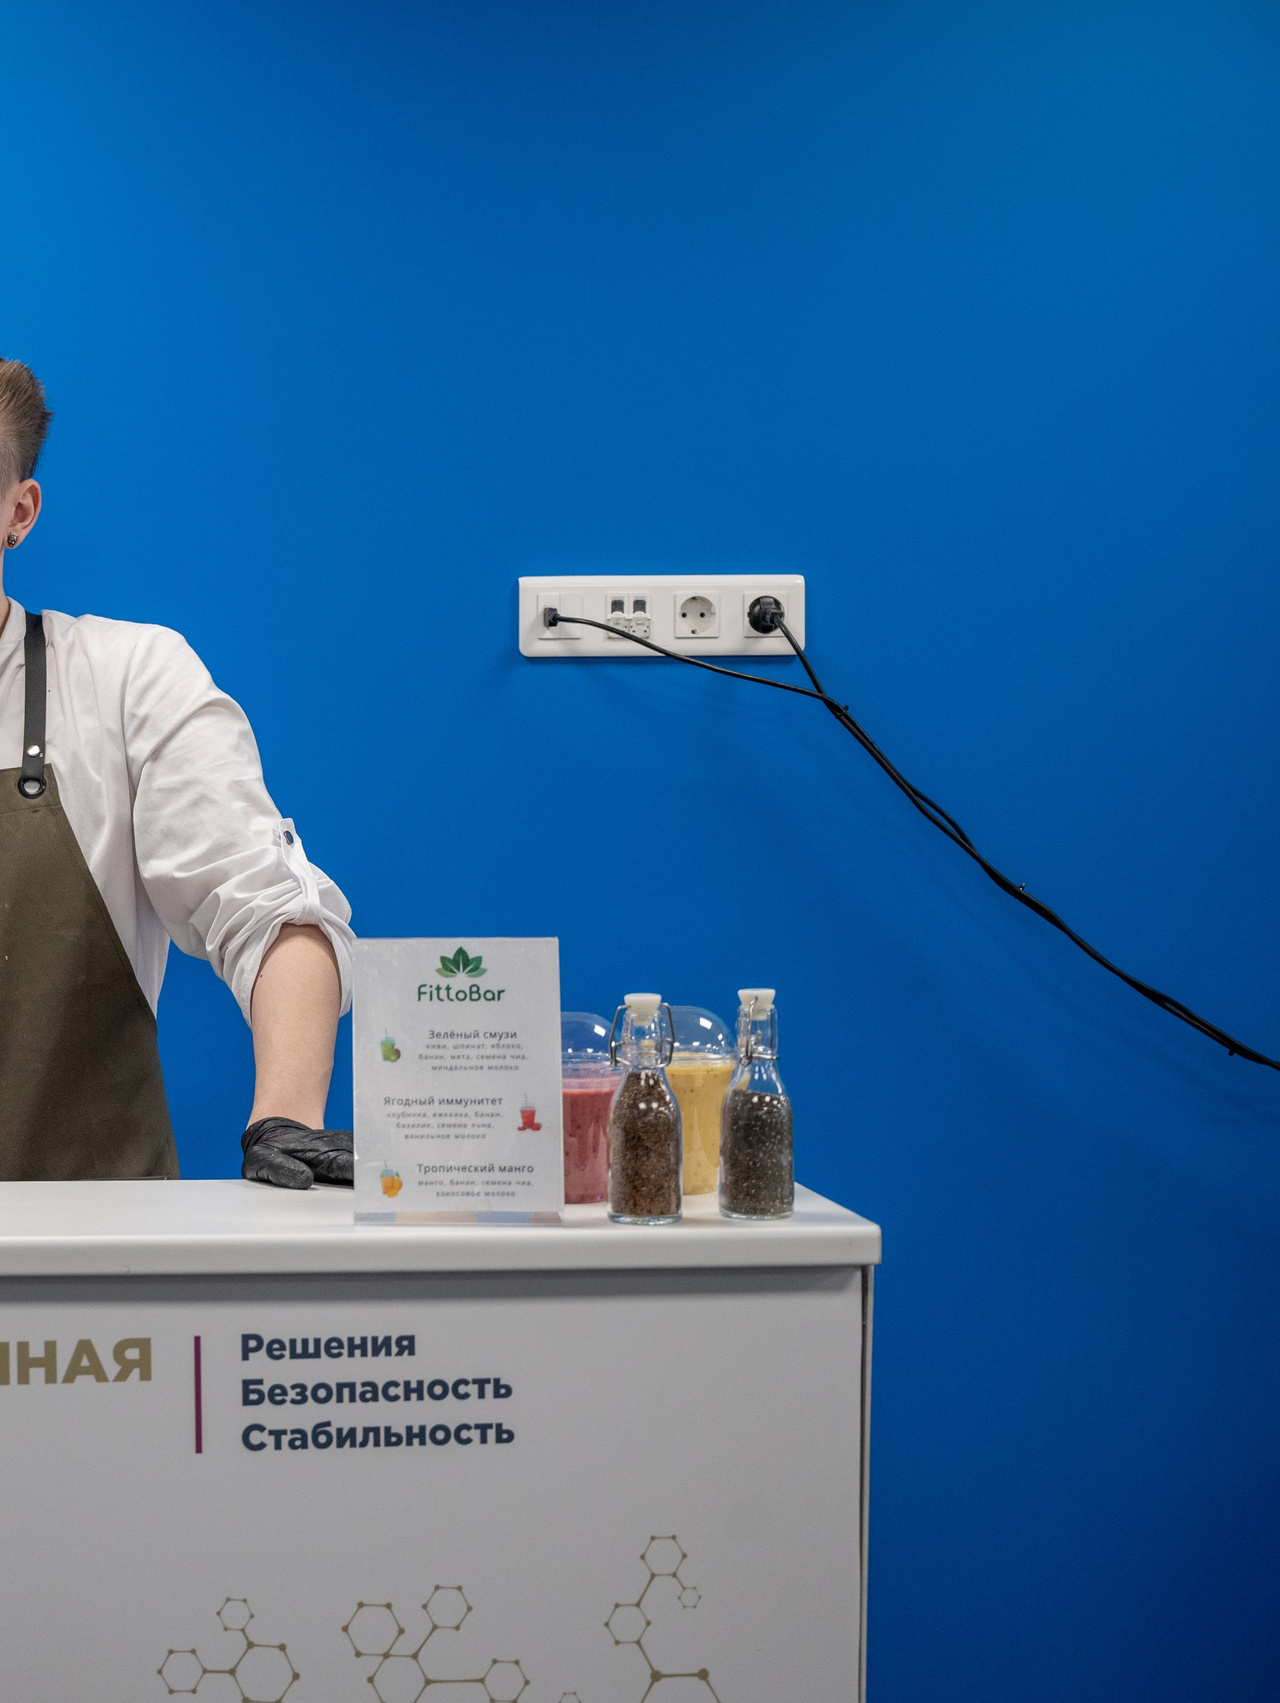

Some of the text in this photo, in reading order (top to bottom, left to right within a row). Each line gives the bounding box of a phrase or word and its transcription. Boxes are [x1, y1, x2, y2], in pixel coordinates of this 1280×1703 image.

[417, 983, 506, 1002] FittoBar
[428, 1029, 518, 1041] Зелёный смузи
[491, 1042, 524, 1050] яблоко,
[383, 1096, 503, 1108] Ягодный иммунитет
[417, 1164, 495, 1175] Тропический
[241, 1333, 416, 1362] Решения
[241, 1377, 513, 1407] Безопасность
[241, 1420, 515, 1452] Стабильность
